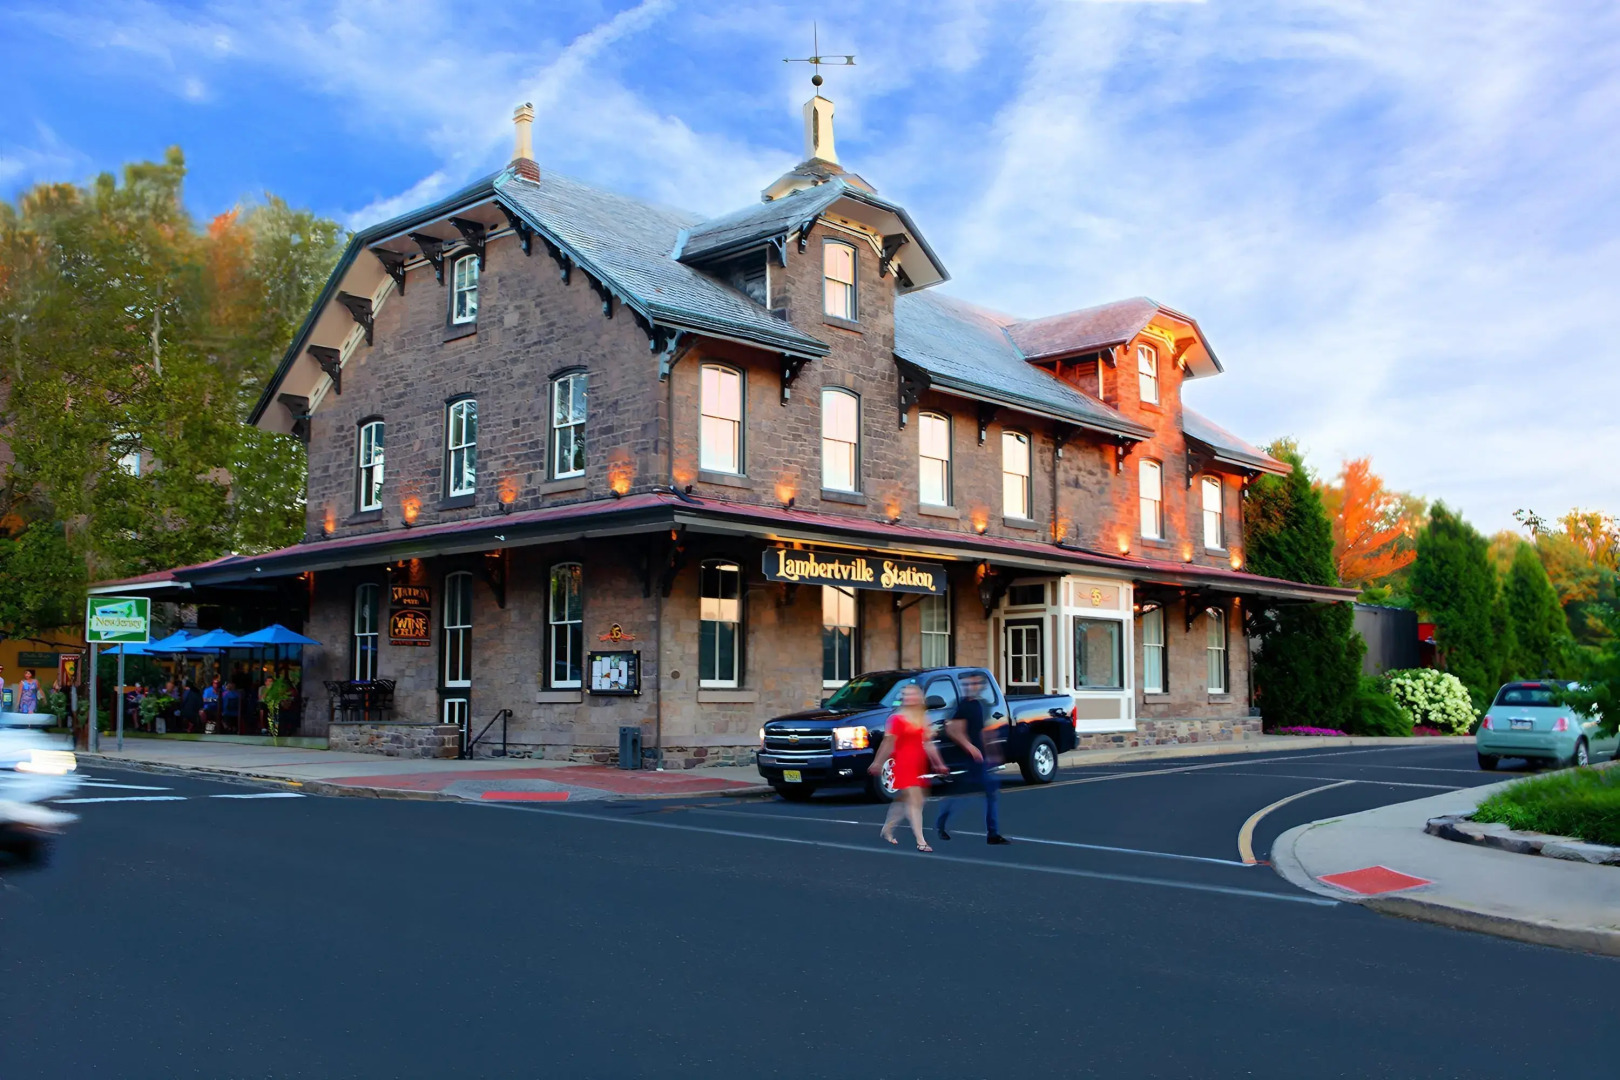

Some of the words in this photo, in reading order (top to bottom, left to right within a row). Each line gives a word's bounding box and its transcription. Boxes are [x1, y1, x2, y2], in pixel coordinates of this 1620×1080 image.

[776, 549, 874, 582] Lambertville
[880, 560, 936, 591] Station
[95, 617, 115, 627] New
[116, 617, 142, 629] Jersey
[395, 617, 426, 629] WINE
